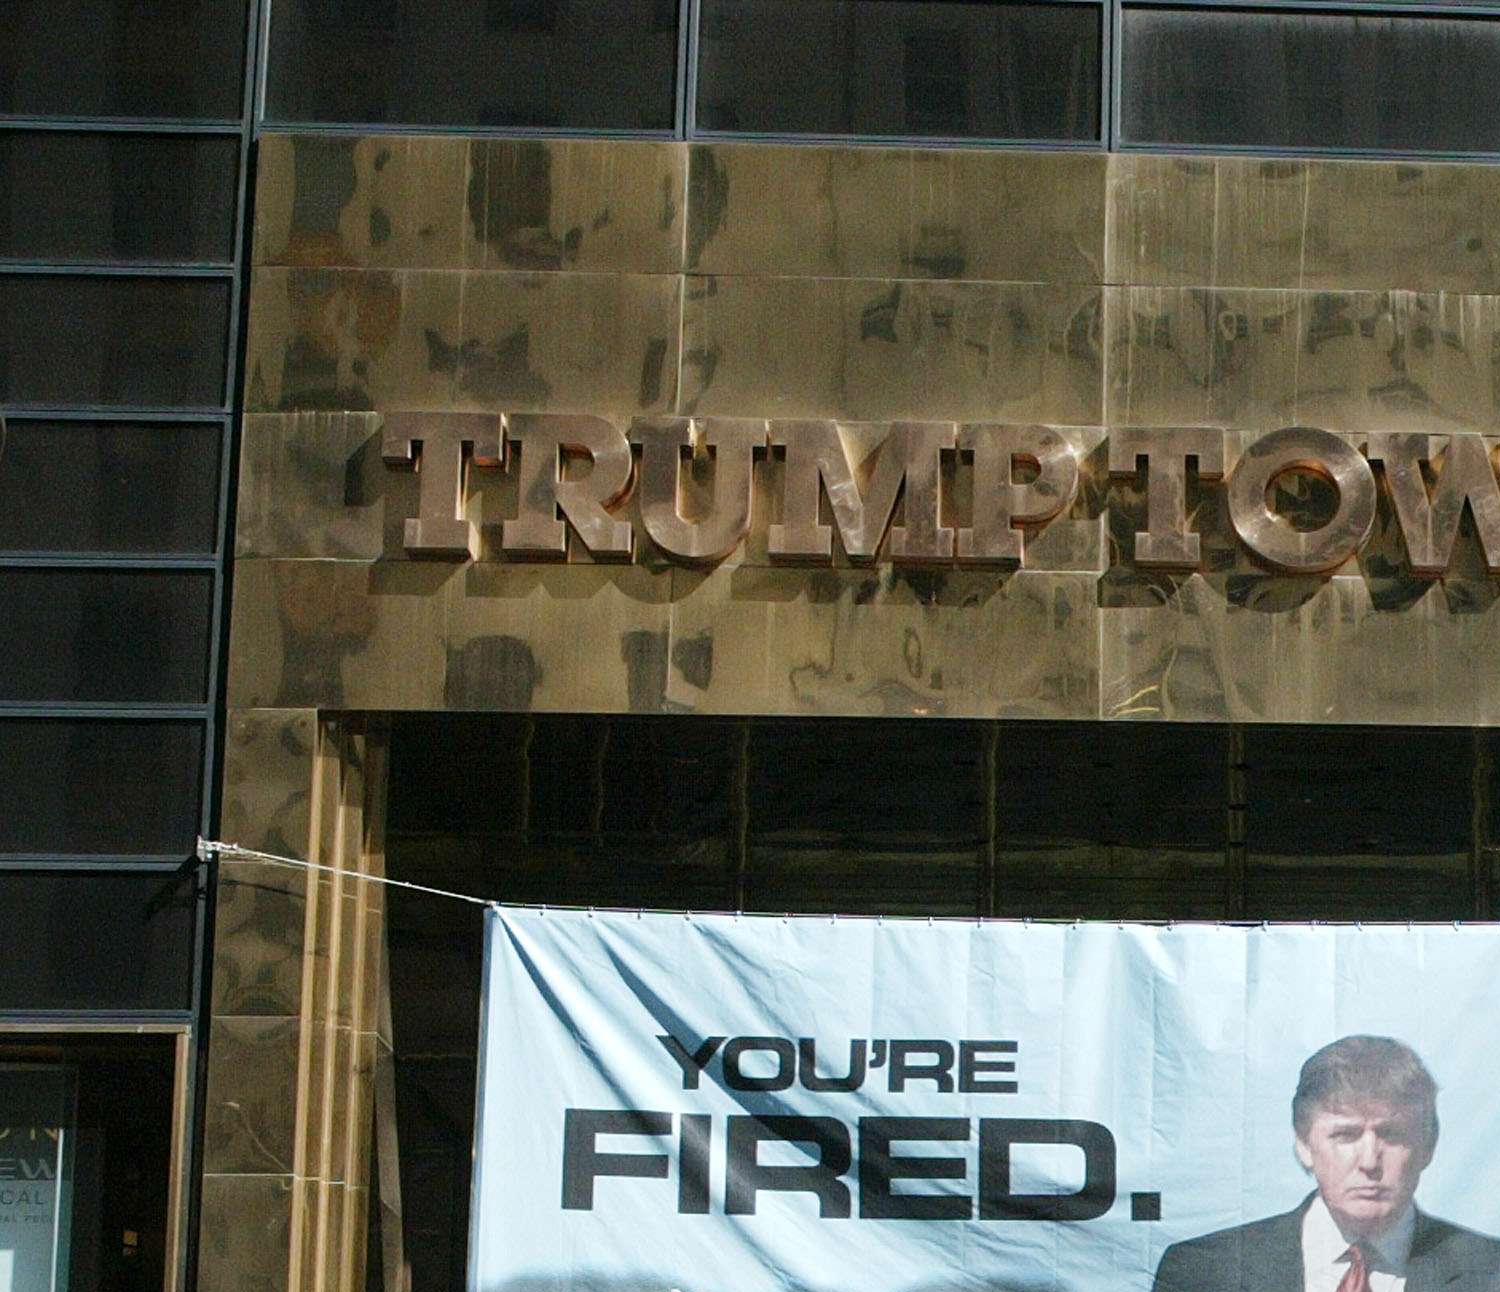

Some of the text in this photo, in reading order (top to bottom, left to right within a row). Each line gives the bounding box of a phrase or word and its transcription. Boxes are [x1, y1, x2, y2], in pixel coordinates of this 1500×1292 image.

[381, 411, 1081, 567] TRUMP
[655, 1034, 1019, 1095] YOU'RE
[561, 1106, 1162, 1222] FIRED.
